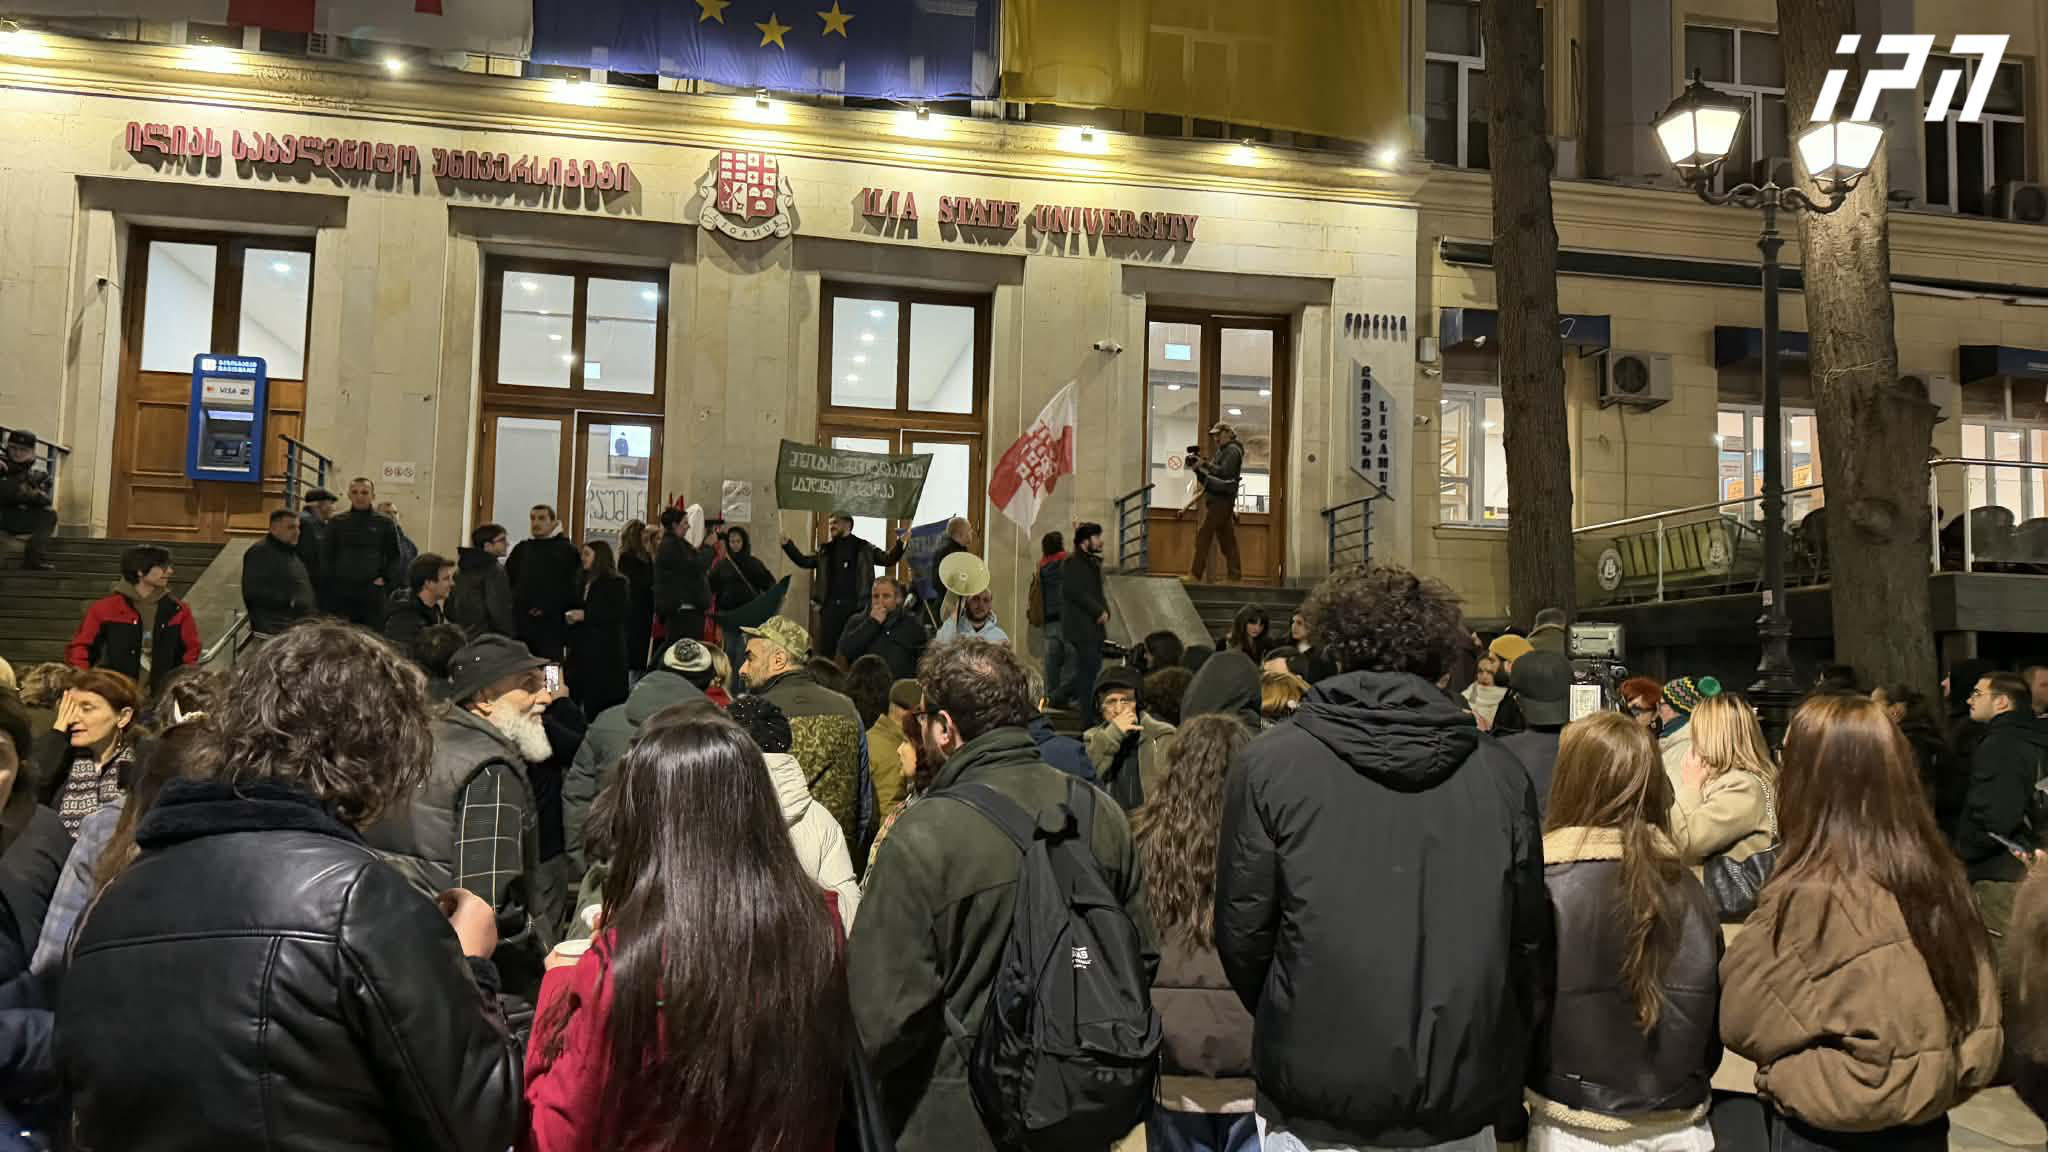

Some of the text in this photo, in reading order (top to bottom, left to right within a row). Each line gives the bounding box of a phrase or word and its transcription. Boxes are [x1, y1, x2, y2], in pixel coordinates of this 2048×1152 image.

[125, 121, 631, 192] ილიას სახელმწიფო უნივერსიტეტი
[862, 187, 1199, 242] ILIA STATE UNIVERSITY
[219, 386, 237, 395] VISA
